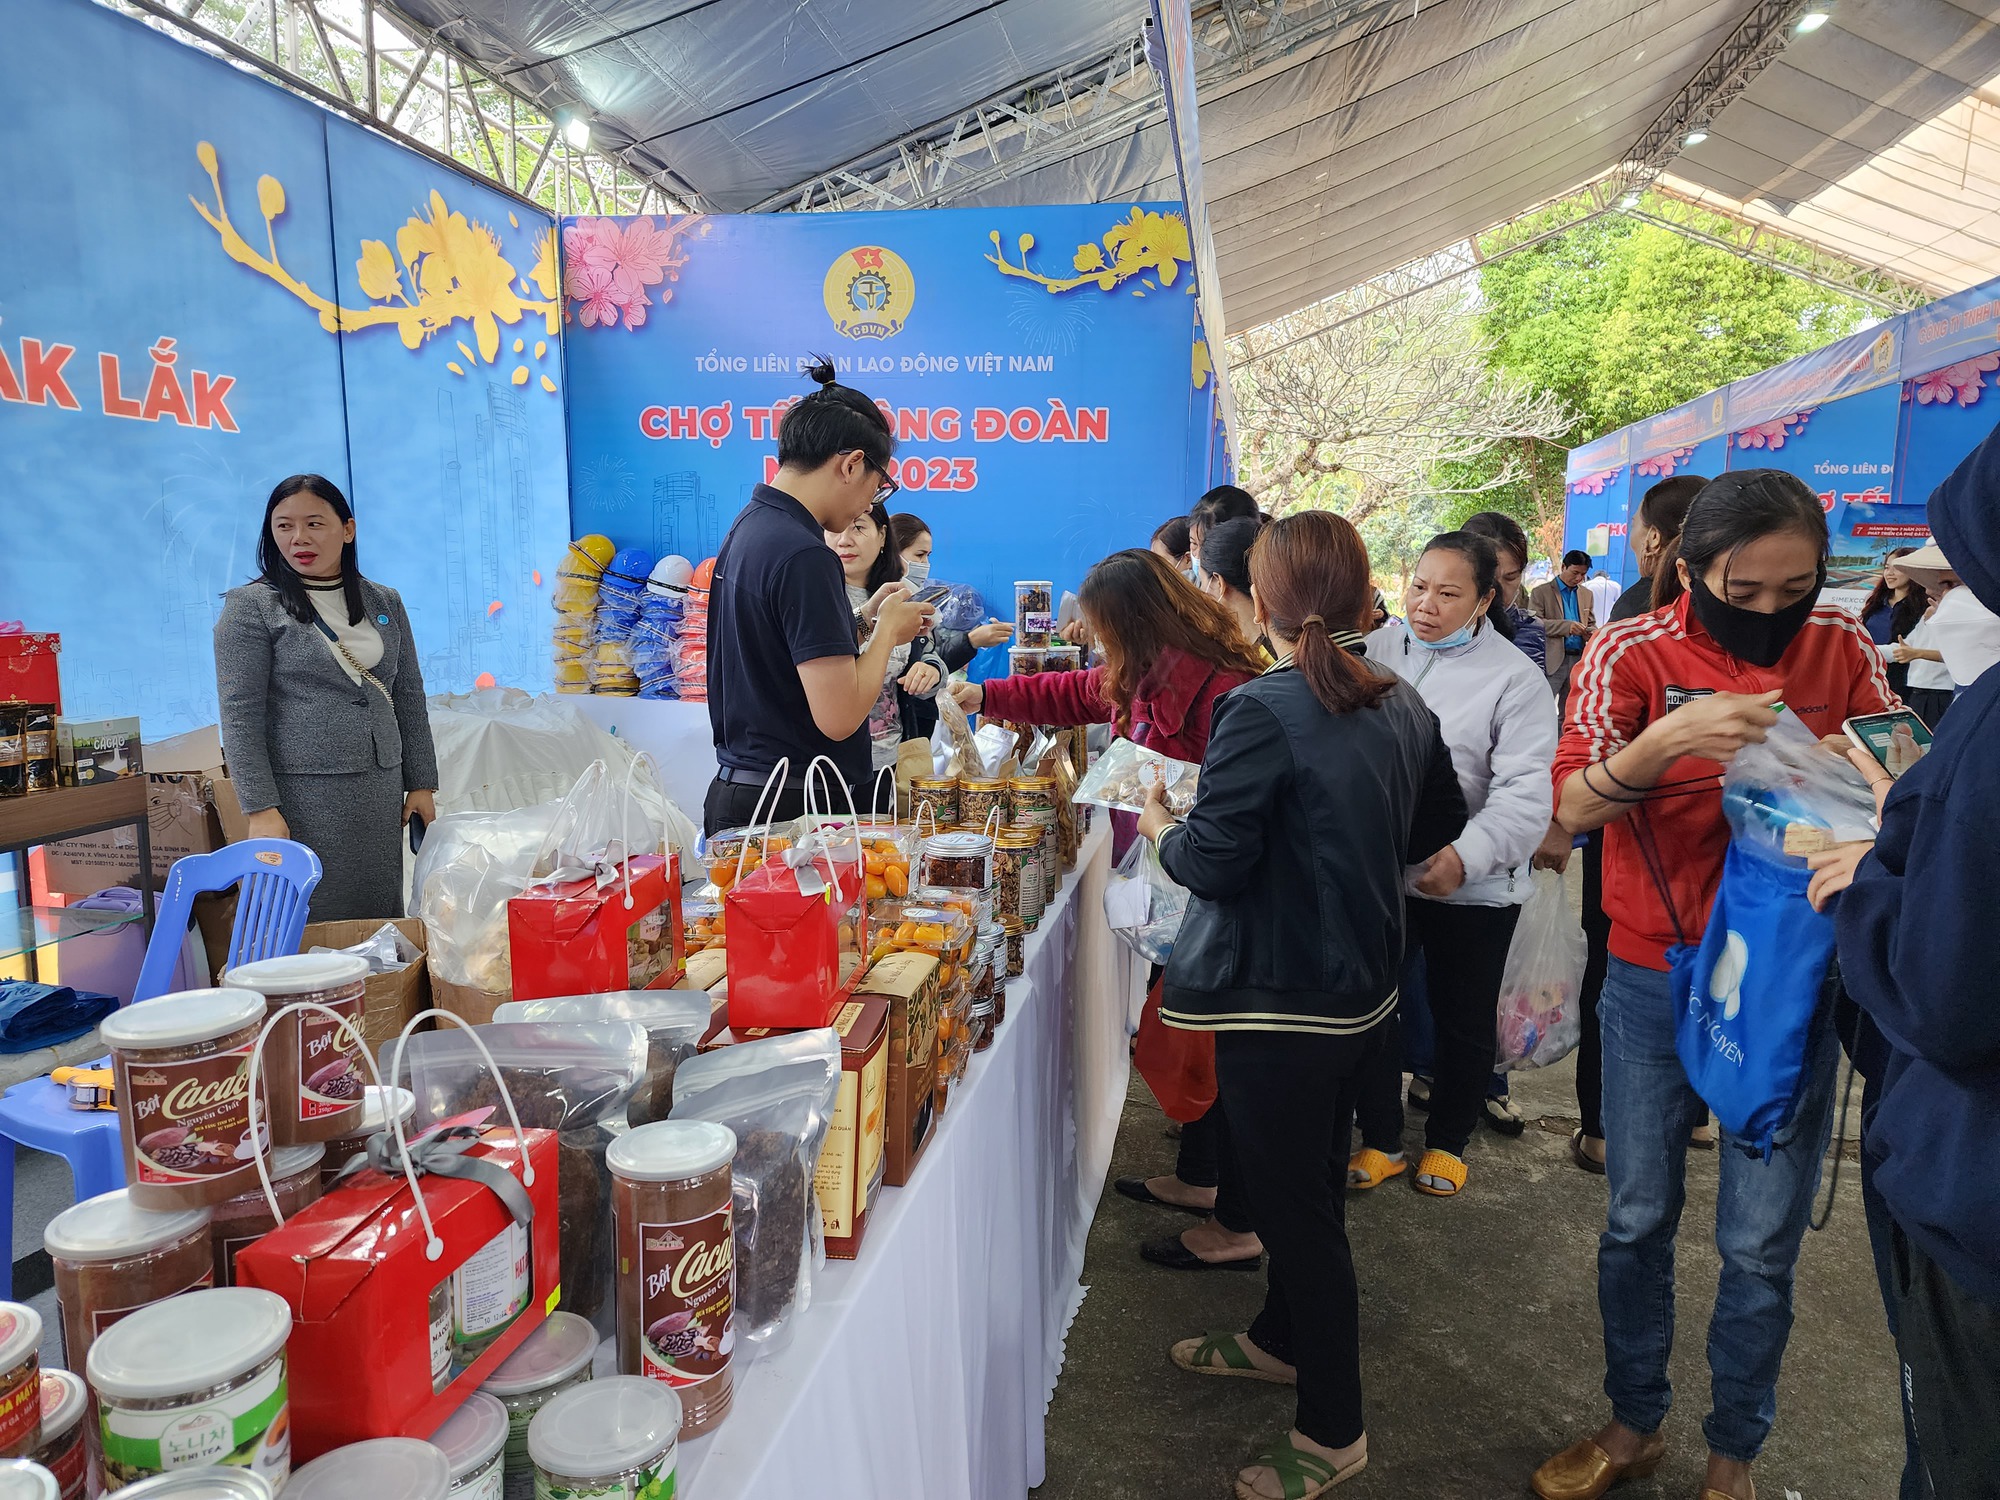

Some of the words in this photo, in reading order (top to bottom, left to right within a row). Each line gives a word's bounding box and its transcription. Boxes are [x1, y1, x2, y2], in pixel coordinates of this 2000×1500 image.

[853, 325, 885, 337] CĐVN
[695, 348, 748, 373] TỔNG
[753, 352, 790, 373] LIÊN
[858, 356, 895, 373] LAO
[900, 352, 959, 376] ĐỘNG
[965, 352, 1003, 377] VIỆT
[1010, 356, 1054, 372] NAM
[98, 336, 240, 433] LẮK
[639, 401, 733, 448] CHỢ
[971, 398, 1110, 442] ĐOÀN
[1814, 460, 1849, 474] TỔNG
[1852, 462, 1877, 474] LIÊN
[305, 1030, 334, 1059] Bột
[134, 1094, 161, 1120] Bột
[161, 1071, 250, 1120] Cacao
[177, 1112, 216, 1128] Nguyên
[217, 1100, 241, 1115] Chất
[646, 1263, 671, 1300] Bột
[671, 1234, 733, 1299] Caca
[684, 1288, 717, 1309] Nguyên
[169, 1426, 227, 1453] 노니차
[202, 1446, 222, 1458] TEA
